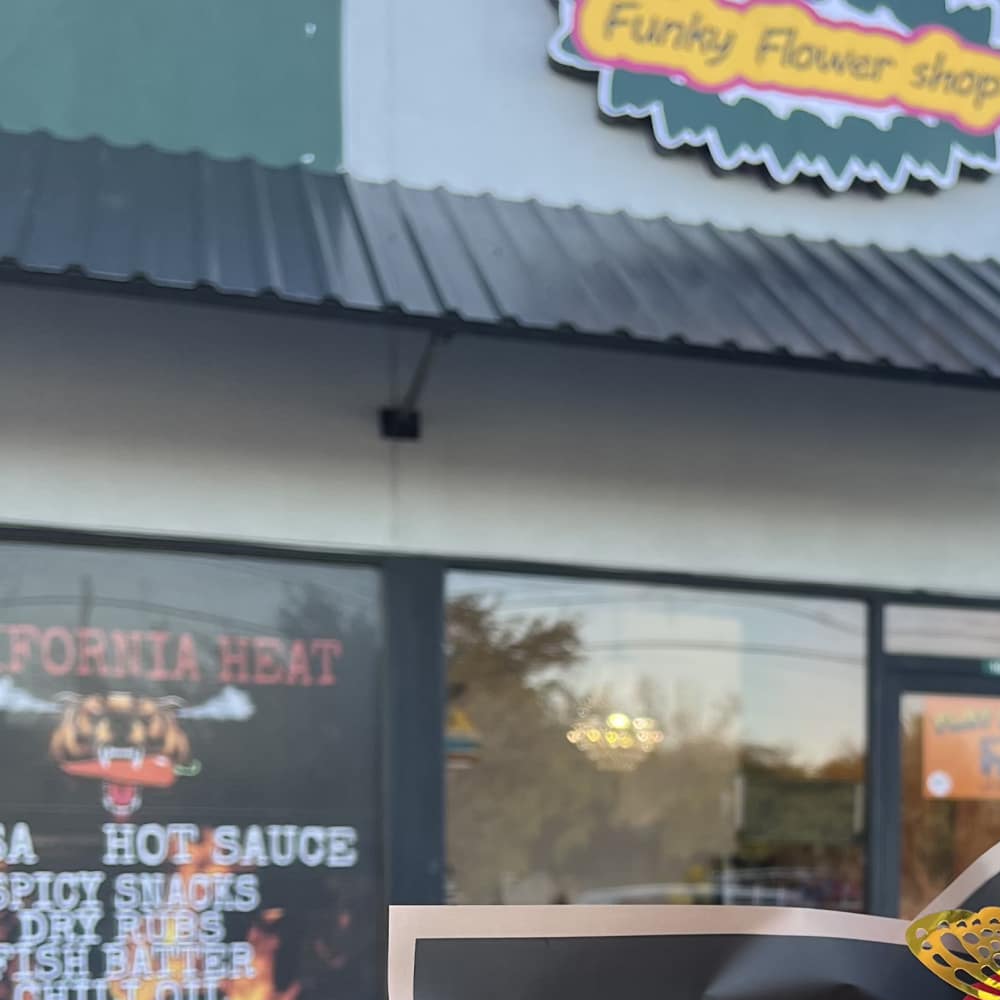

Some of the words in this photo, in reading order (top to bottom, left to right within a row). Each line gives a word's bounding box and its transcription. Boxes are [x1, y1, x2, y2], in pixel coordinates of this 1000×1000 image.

[600, 1, 736, 67] Funky
[754, 26, 898, 84] Flower
[0, 623, 200, 683] FORNIA
[216, 634, 343, 687] HEAT
[0, 822, 39, 866] A
[103, 822, 200, 867] HOT
[211, 824, 358, 868] SAUCE
[113, 872, 261, 912] SNACKS
[18, 908, 104, 946] DRY
[116, 908, 226, 945] RUBS
[103, 941, 257, 982] BATTER
